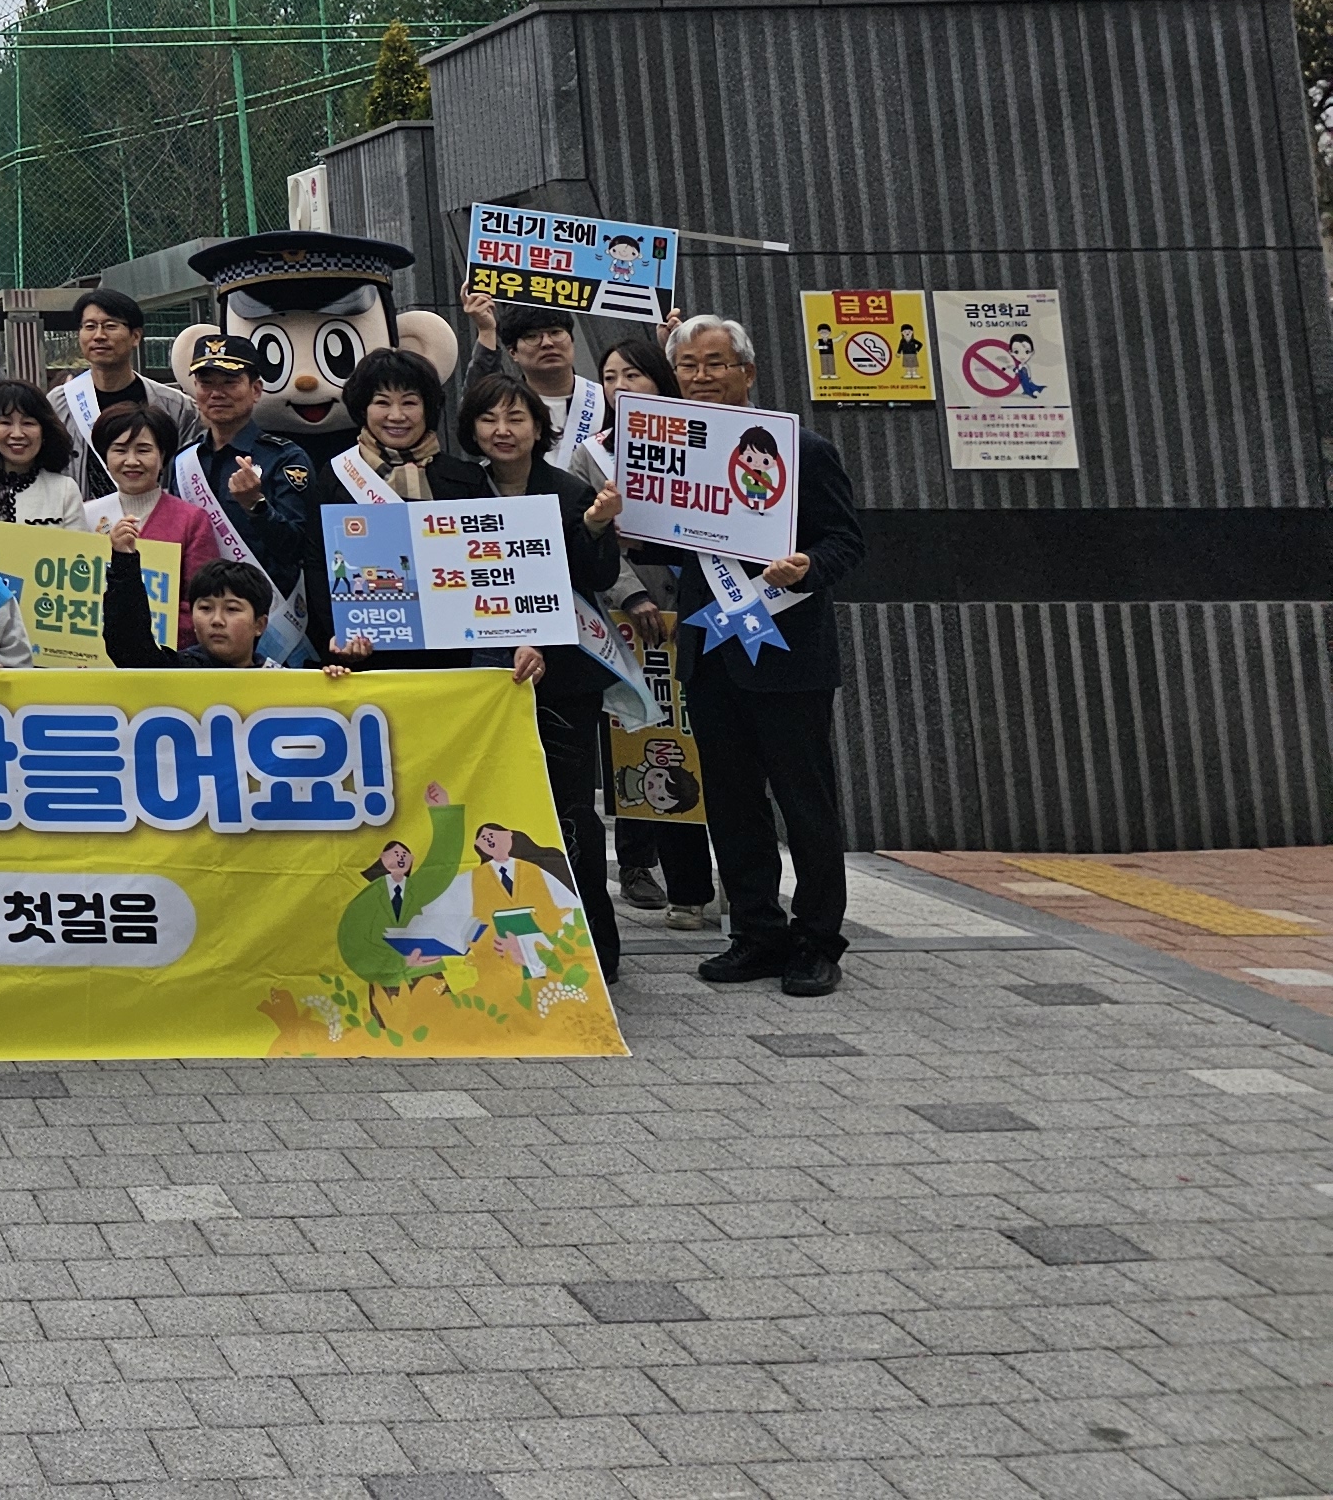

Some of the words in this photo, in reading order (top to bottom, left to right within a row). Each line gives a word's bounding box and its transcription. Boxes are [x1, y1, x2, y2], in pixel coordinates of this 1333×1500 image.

[481, 210, 546, 240] 건너기
[553, 219, 597, 247] 전에
[478, 240, 521, 266] 뛰지
[530, 246, 573, 273] 말고
[473, 268, 524, 297] 좌우
[530, 275, 592, 307] 확인!
[964, 303, 1031, 318] 금연학교
[628, 410, 708, 449] 휴대폰을
[626, 441, 686, 477] 보면서
[626, 471, 664, 504] 걷지
[671, 479, 733, 516] 맙시다
[423, 514, 457, 534] 1단
[460, 514, 505, 533] 멈춤!
[467, 539, 502, 559] 2쪽
[506, 538, 552, 559] 저쪽!
[431, 567, 468, 588] 3초
[470, 567, 516, 587] 동안!
[348, 608, 407, 625] 어린이
[474, 594, 511, 615] 4고
[514, 594, 561, 615] 예방!
[3, 891, 159, 945] 첫걸음
